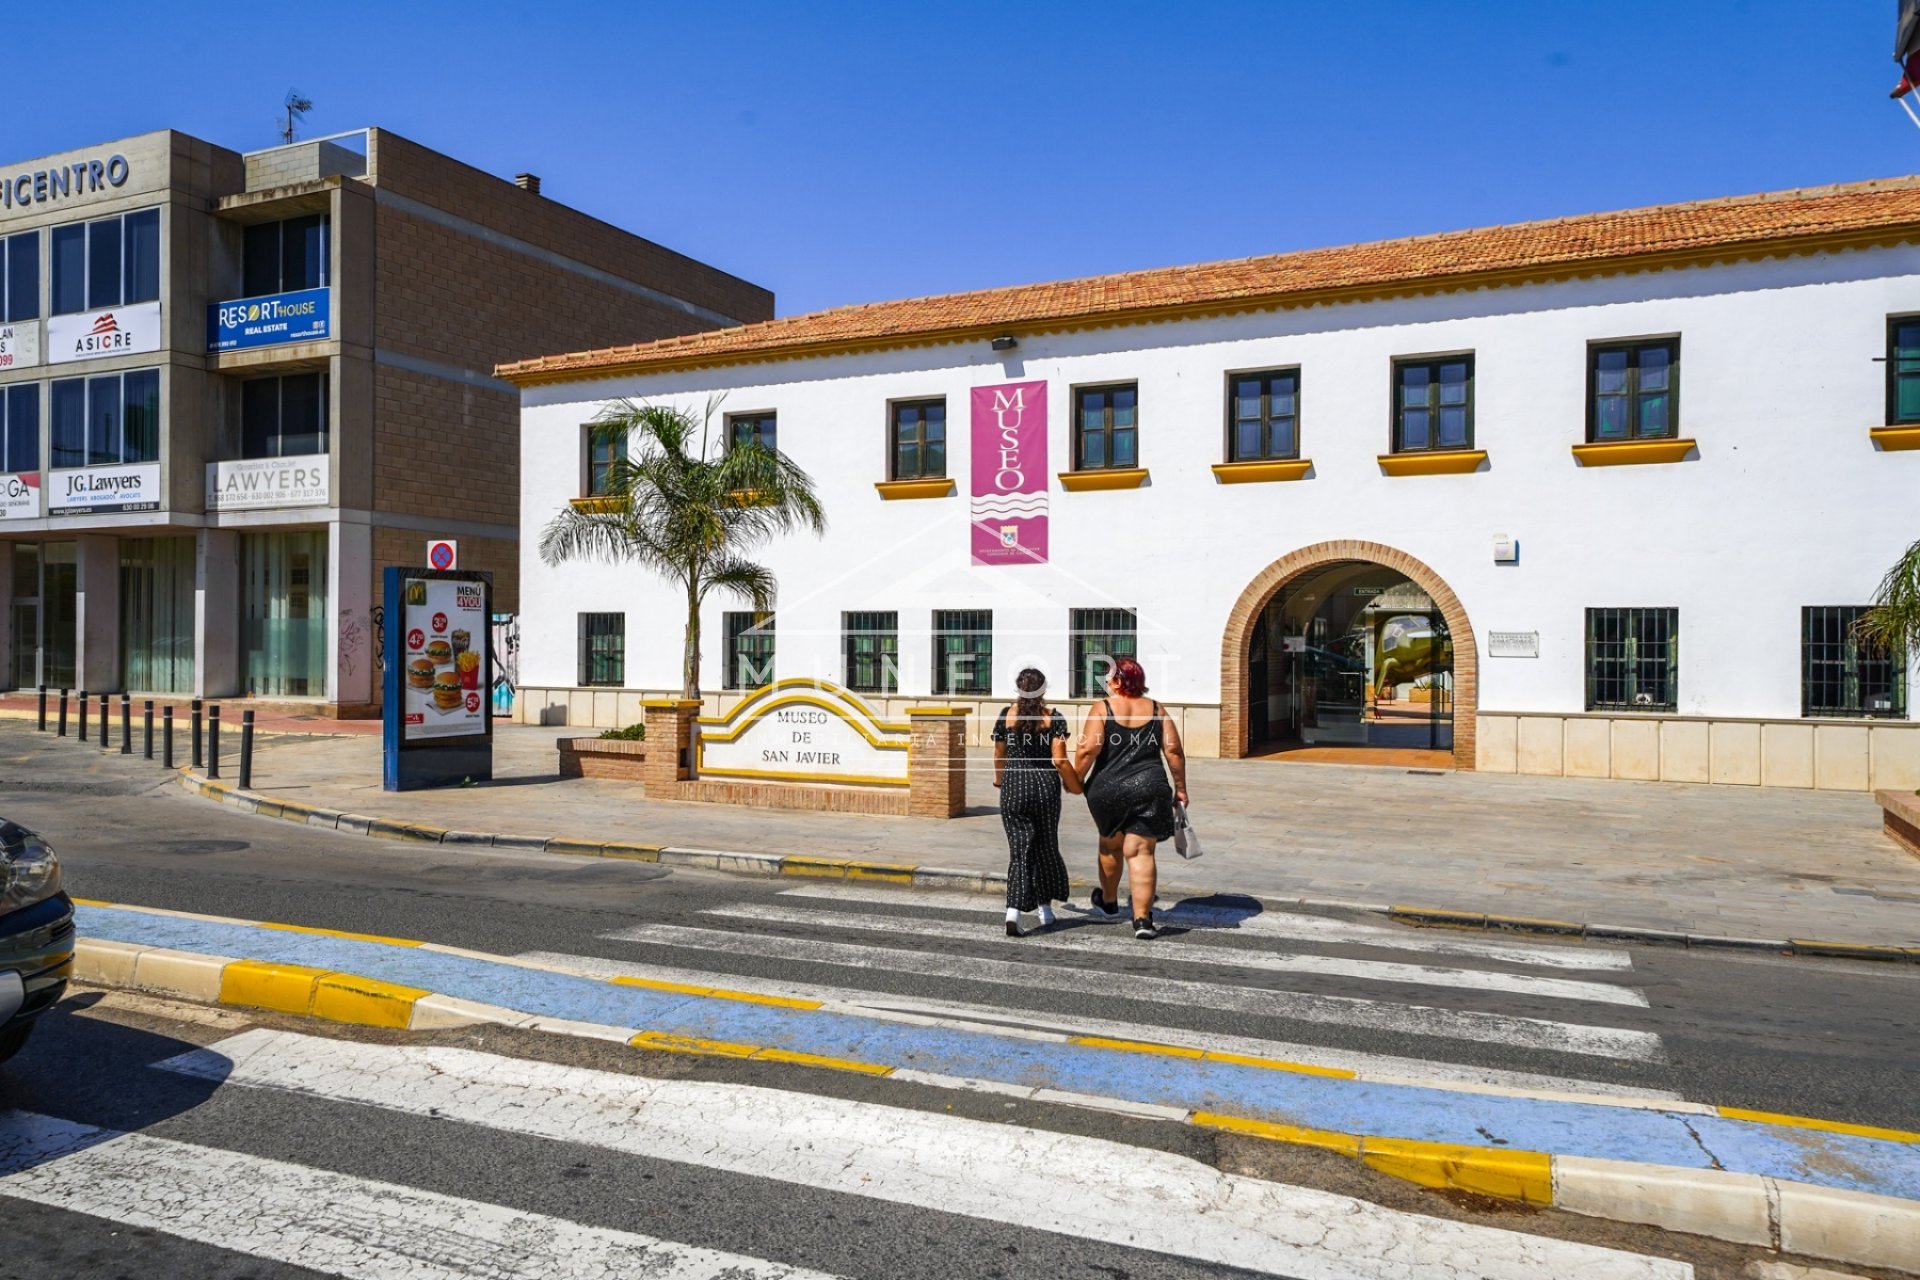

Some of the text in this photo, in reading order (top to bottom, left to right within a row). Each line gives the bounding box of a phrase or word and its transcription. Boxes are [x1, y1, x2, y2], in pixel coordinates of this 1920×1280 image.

[245, 322, 288, 335] REAL ESTATE
[75, 332, 131, 352] ASICRE
[991, 388, 1028, 491] MUSEO
[213, 467, 321, 493] LAWYERS
[457, 583, 481, 596] MENÚ
[457, 595, 481, 608] 4YOU
[778, 711, 828, 724] MUSEO
[792, 732, 812, 744] DE
[762, 750, 841, 765] SAN JAVIER
